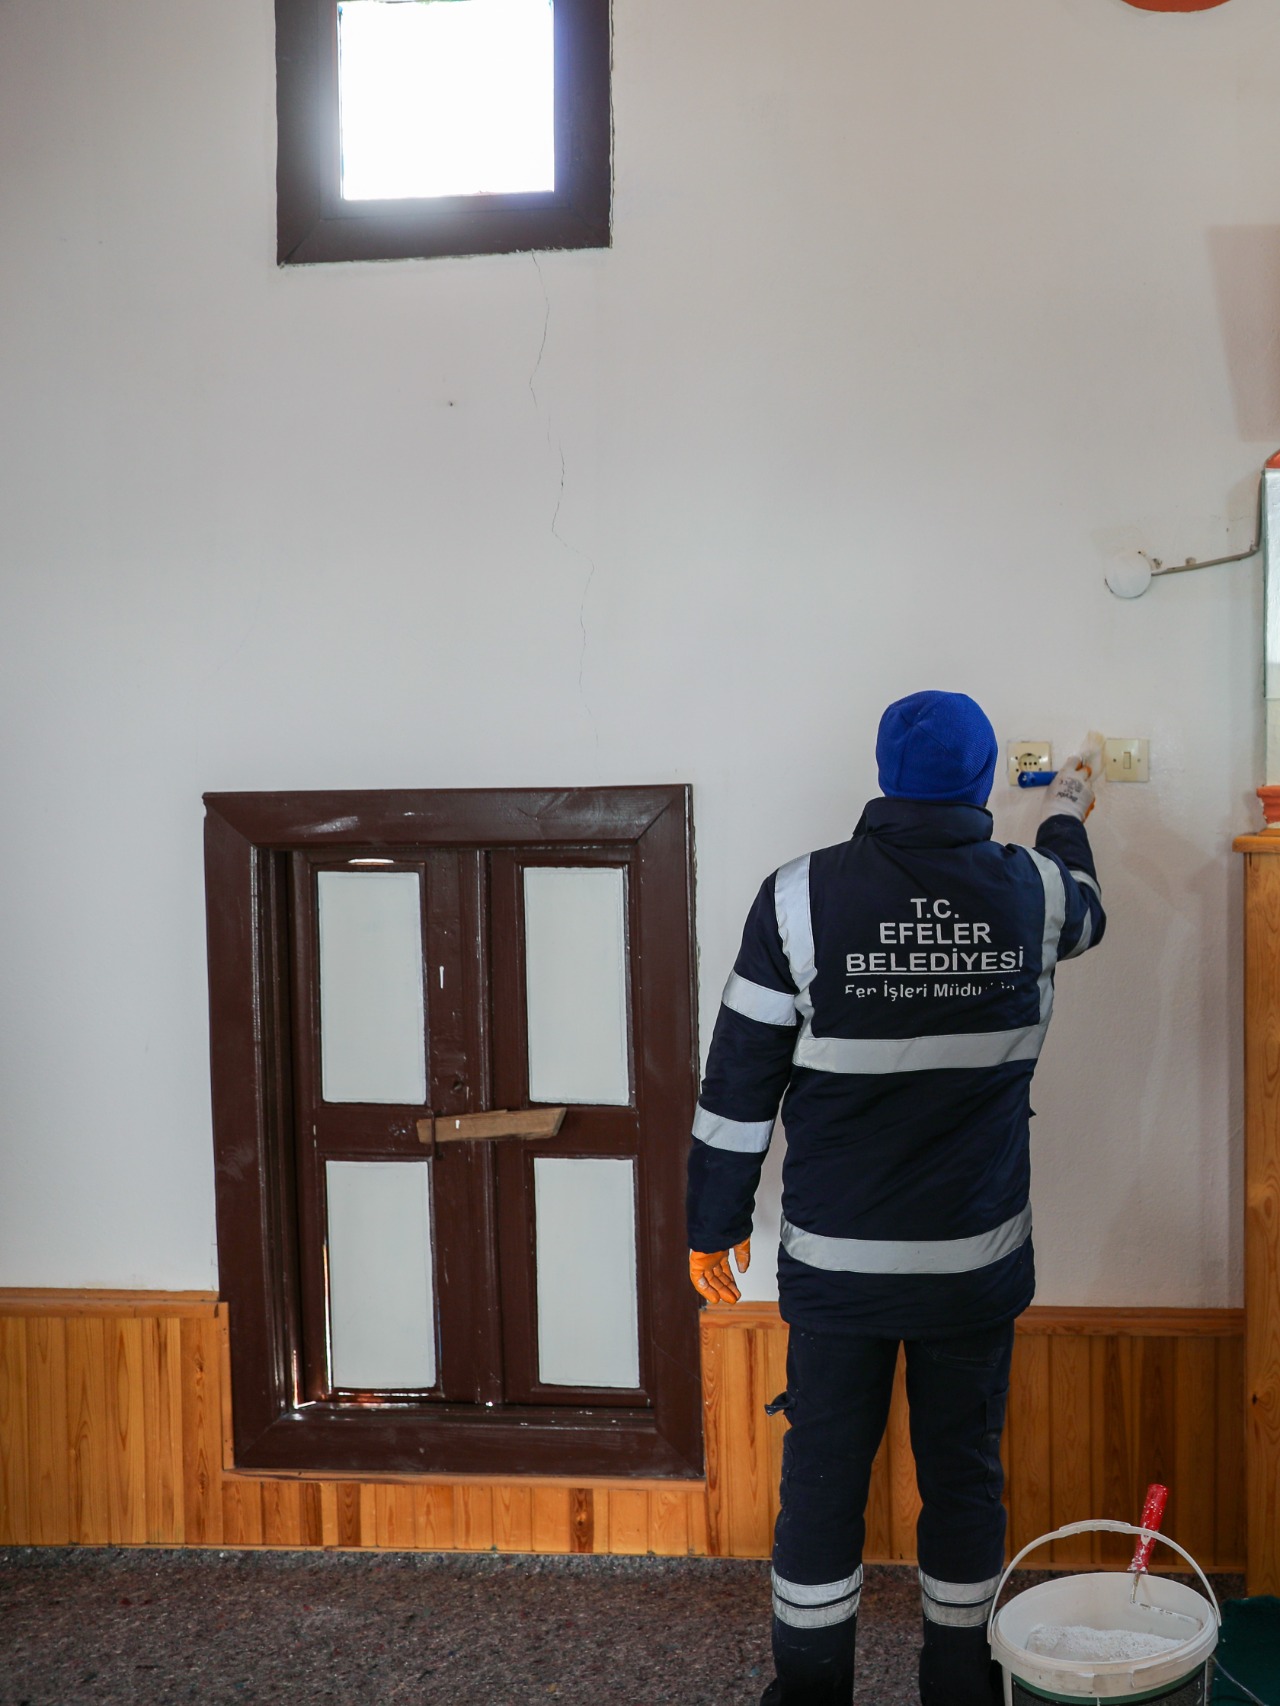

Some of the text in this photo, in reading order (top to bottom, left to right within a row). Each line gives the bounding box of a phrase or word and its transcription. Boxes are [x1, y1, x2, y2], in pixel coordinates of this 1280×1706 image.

[909, 897, 960, 919] T.C.
[878, 921, 992, 945] EFELER
[845, 945, 1024, 972] BELEDİYESİ
[883, 980, 928, 1002] İşleri
